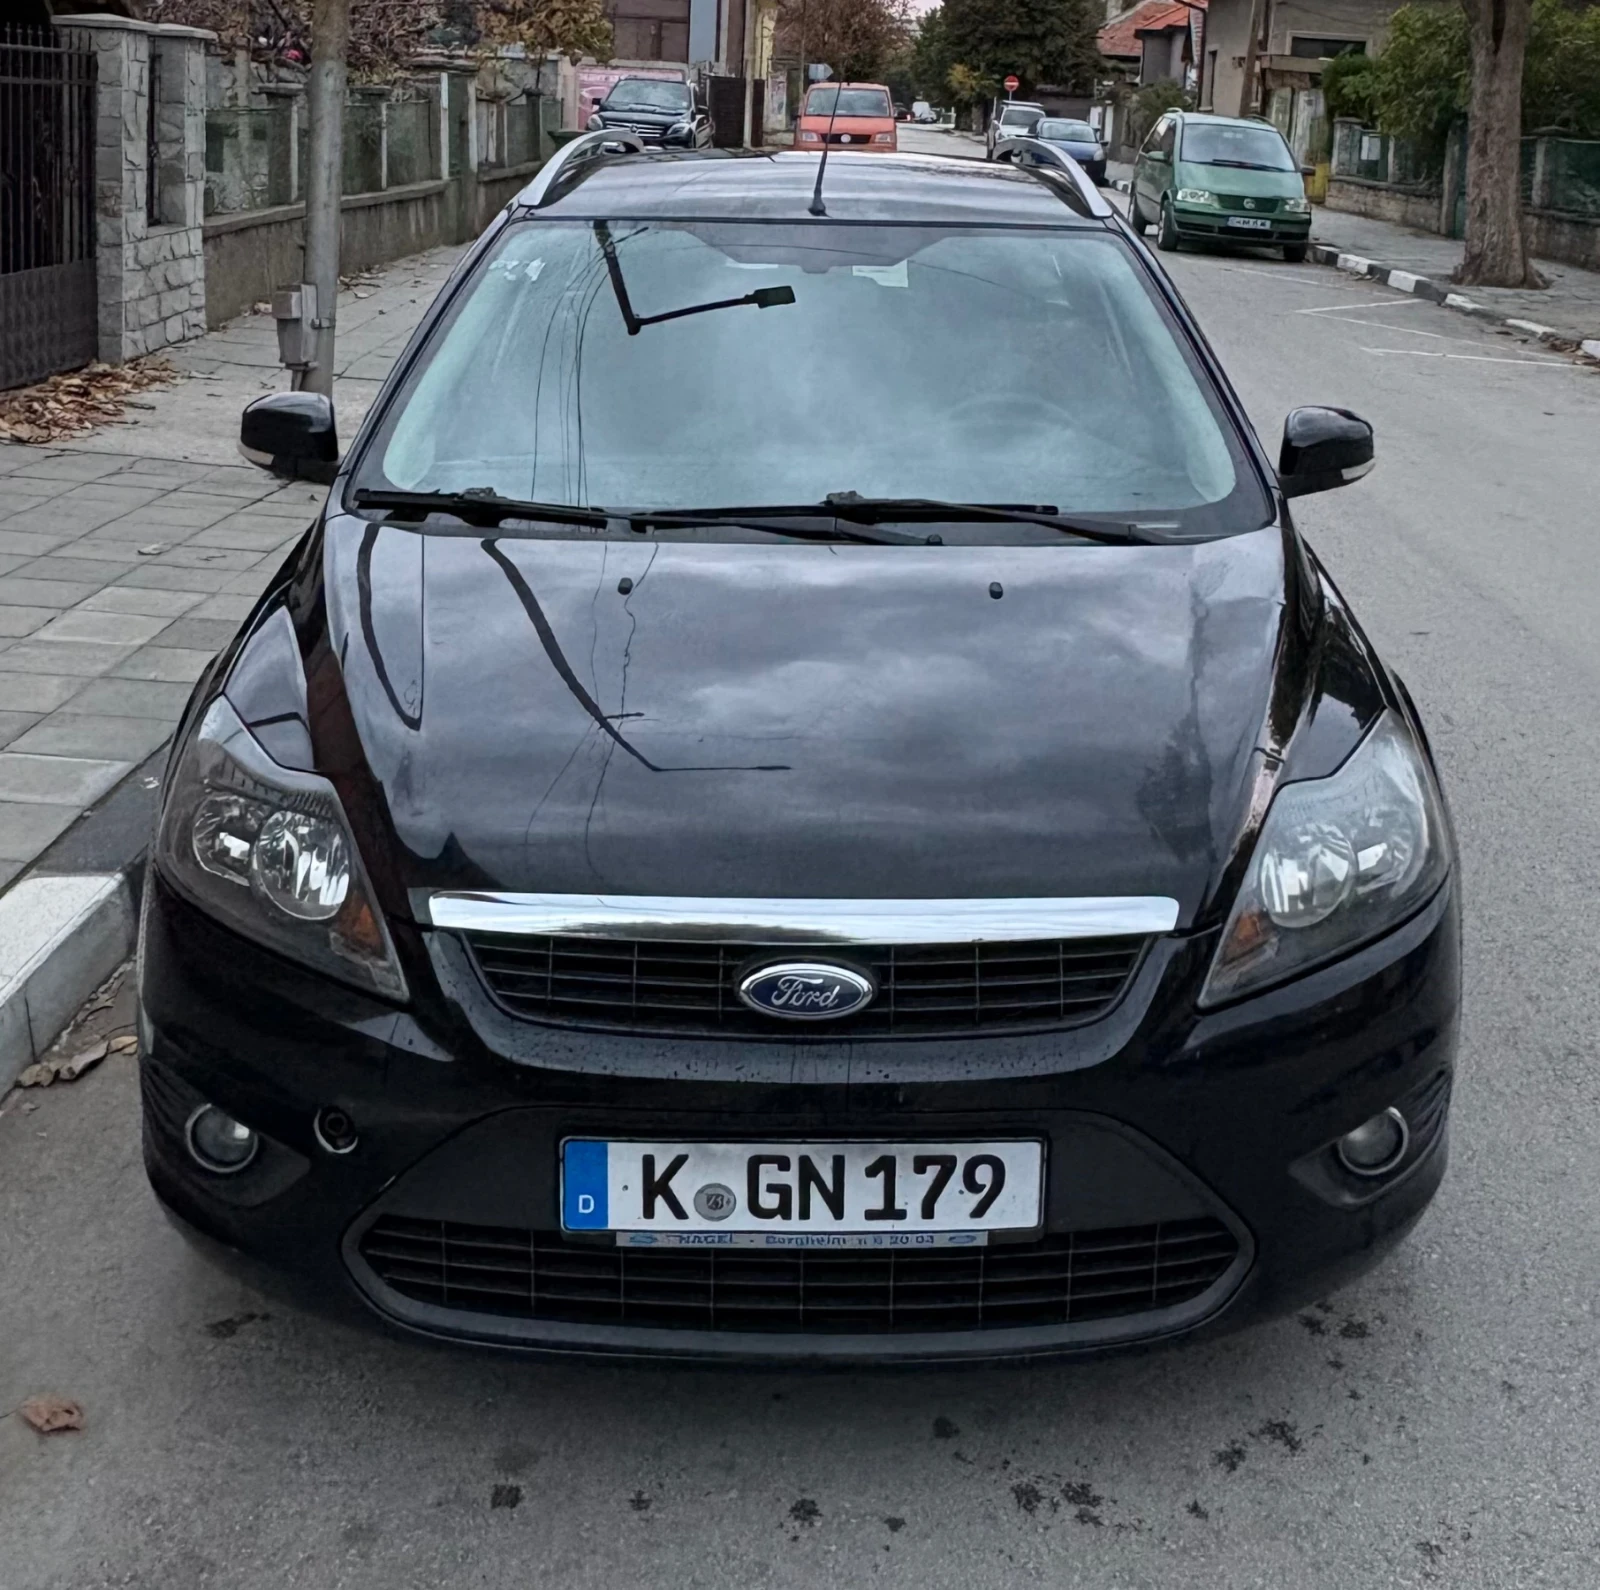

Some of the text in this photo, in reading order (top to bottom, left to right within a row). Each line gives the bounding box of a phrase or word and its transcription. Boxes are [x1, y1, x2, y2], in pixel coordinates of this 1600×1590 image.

[771, 975, 841, 1007] Ford
[642, 1154, 1007, 1221] K GN 179
[578, 1194, 595, 1214] D
